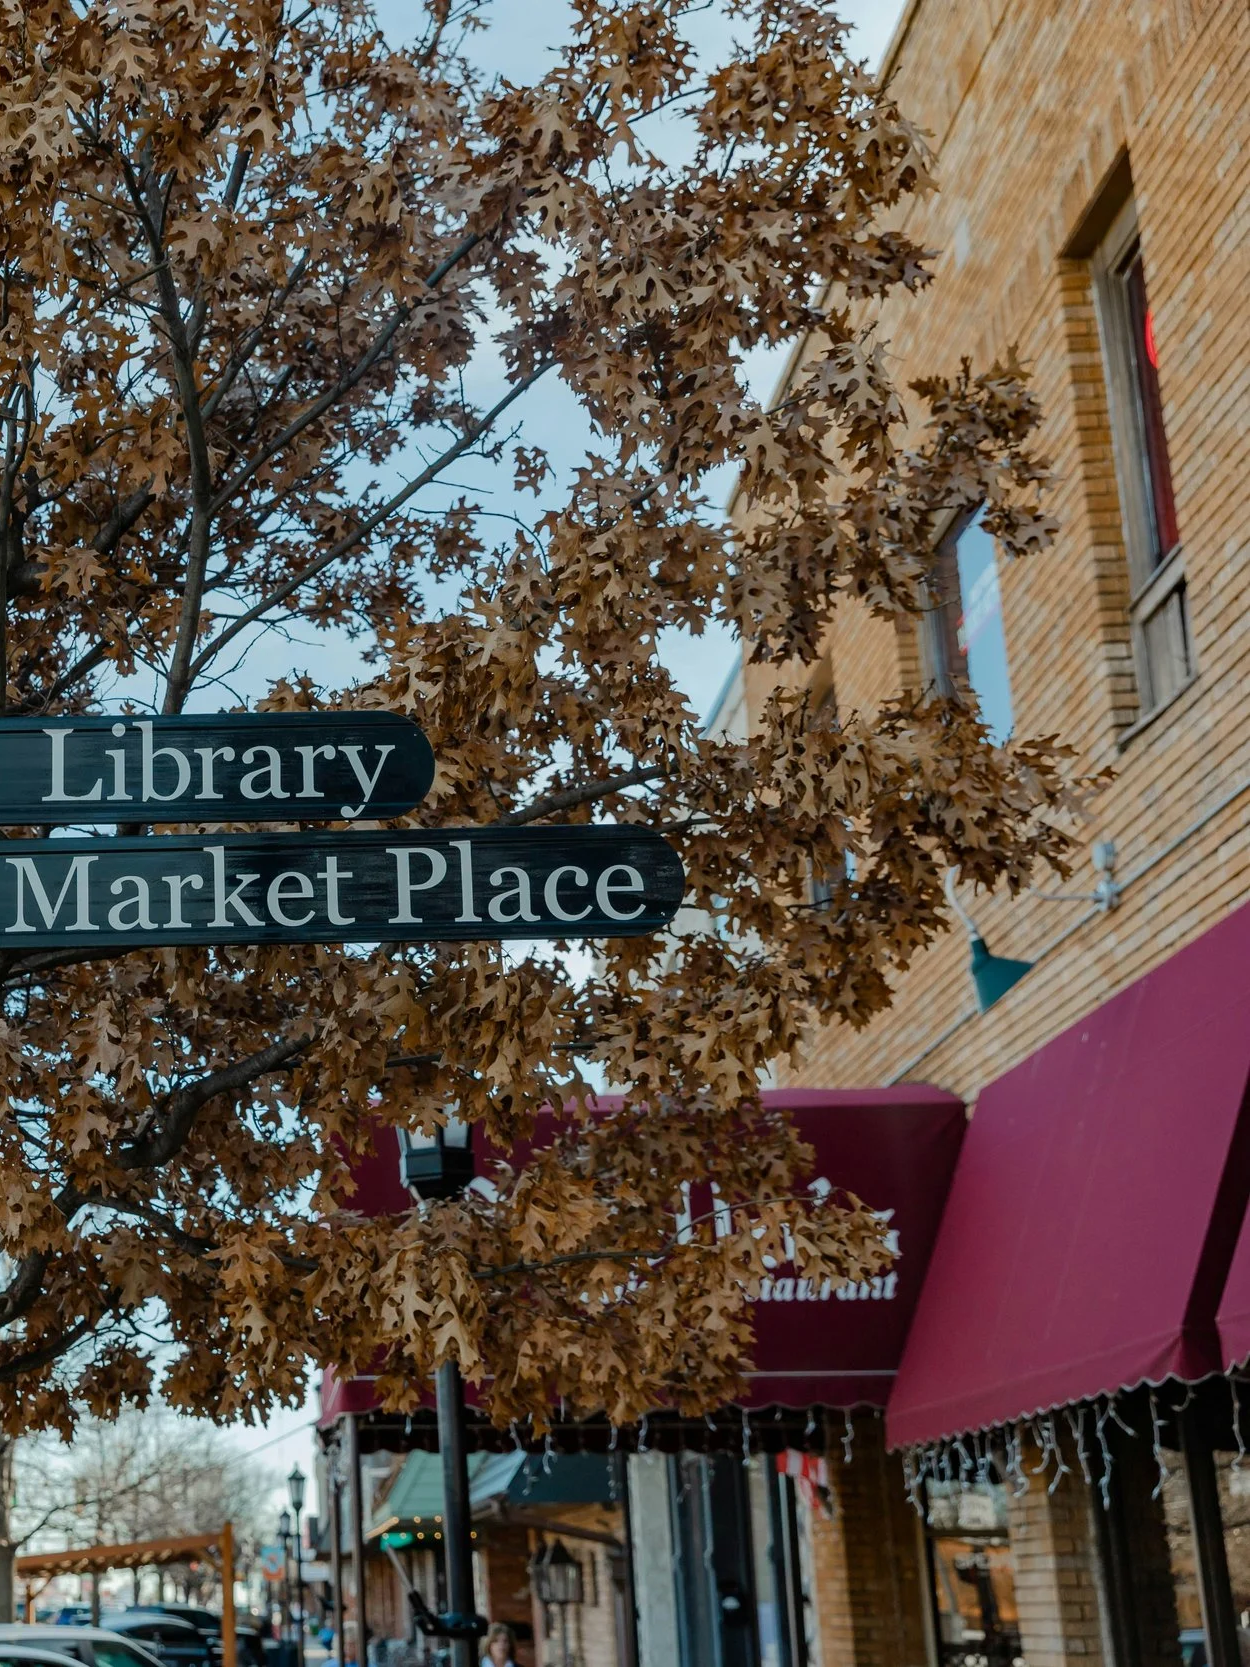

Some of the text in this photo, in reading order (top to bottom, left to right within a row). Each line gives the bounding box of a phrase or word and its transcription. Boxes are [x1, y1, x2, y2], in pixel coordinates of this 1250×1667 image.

[41, 720, 396, 818] Library
[4, 839, 647, 933] Market Place
[734, 1271, 899, 1302] taurant
